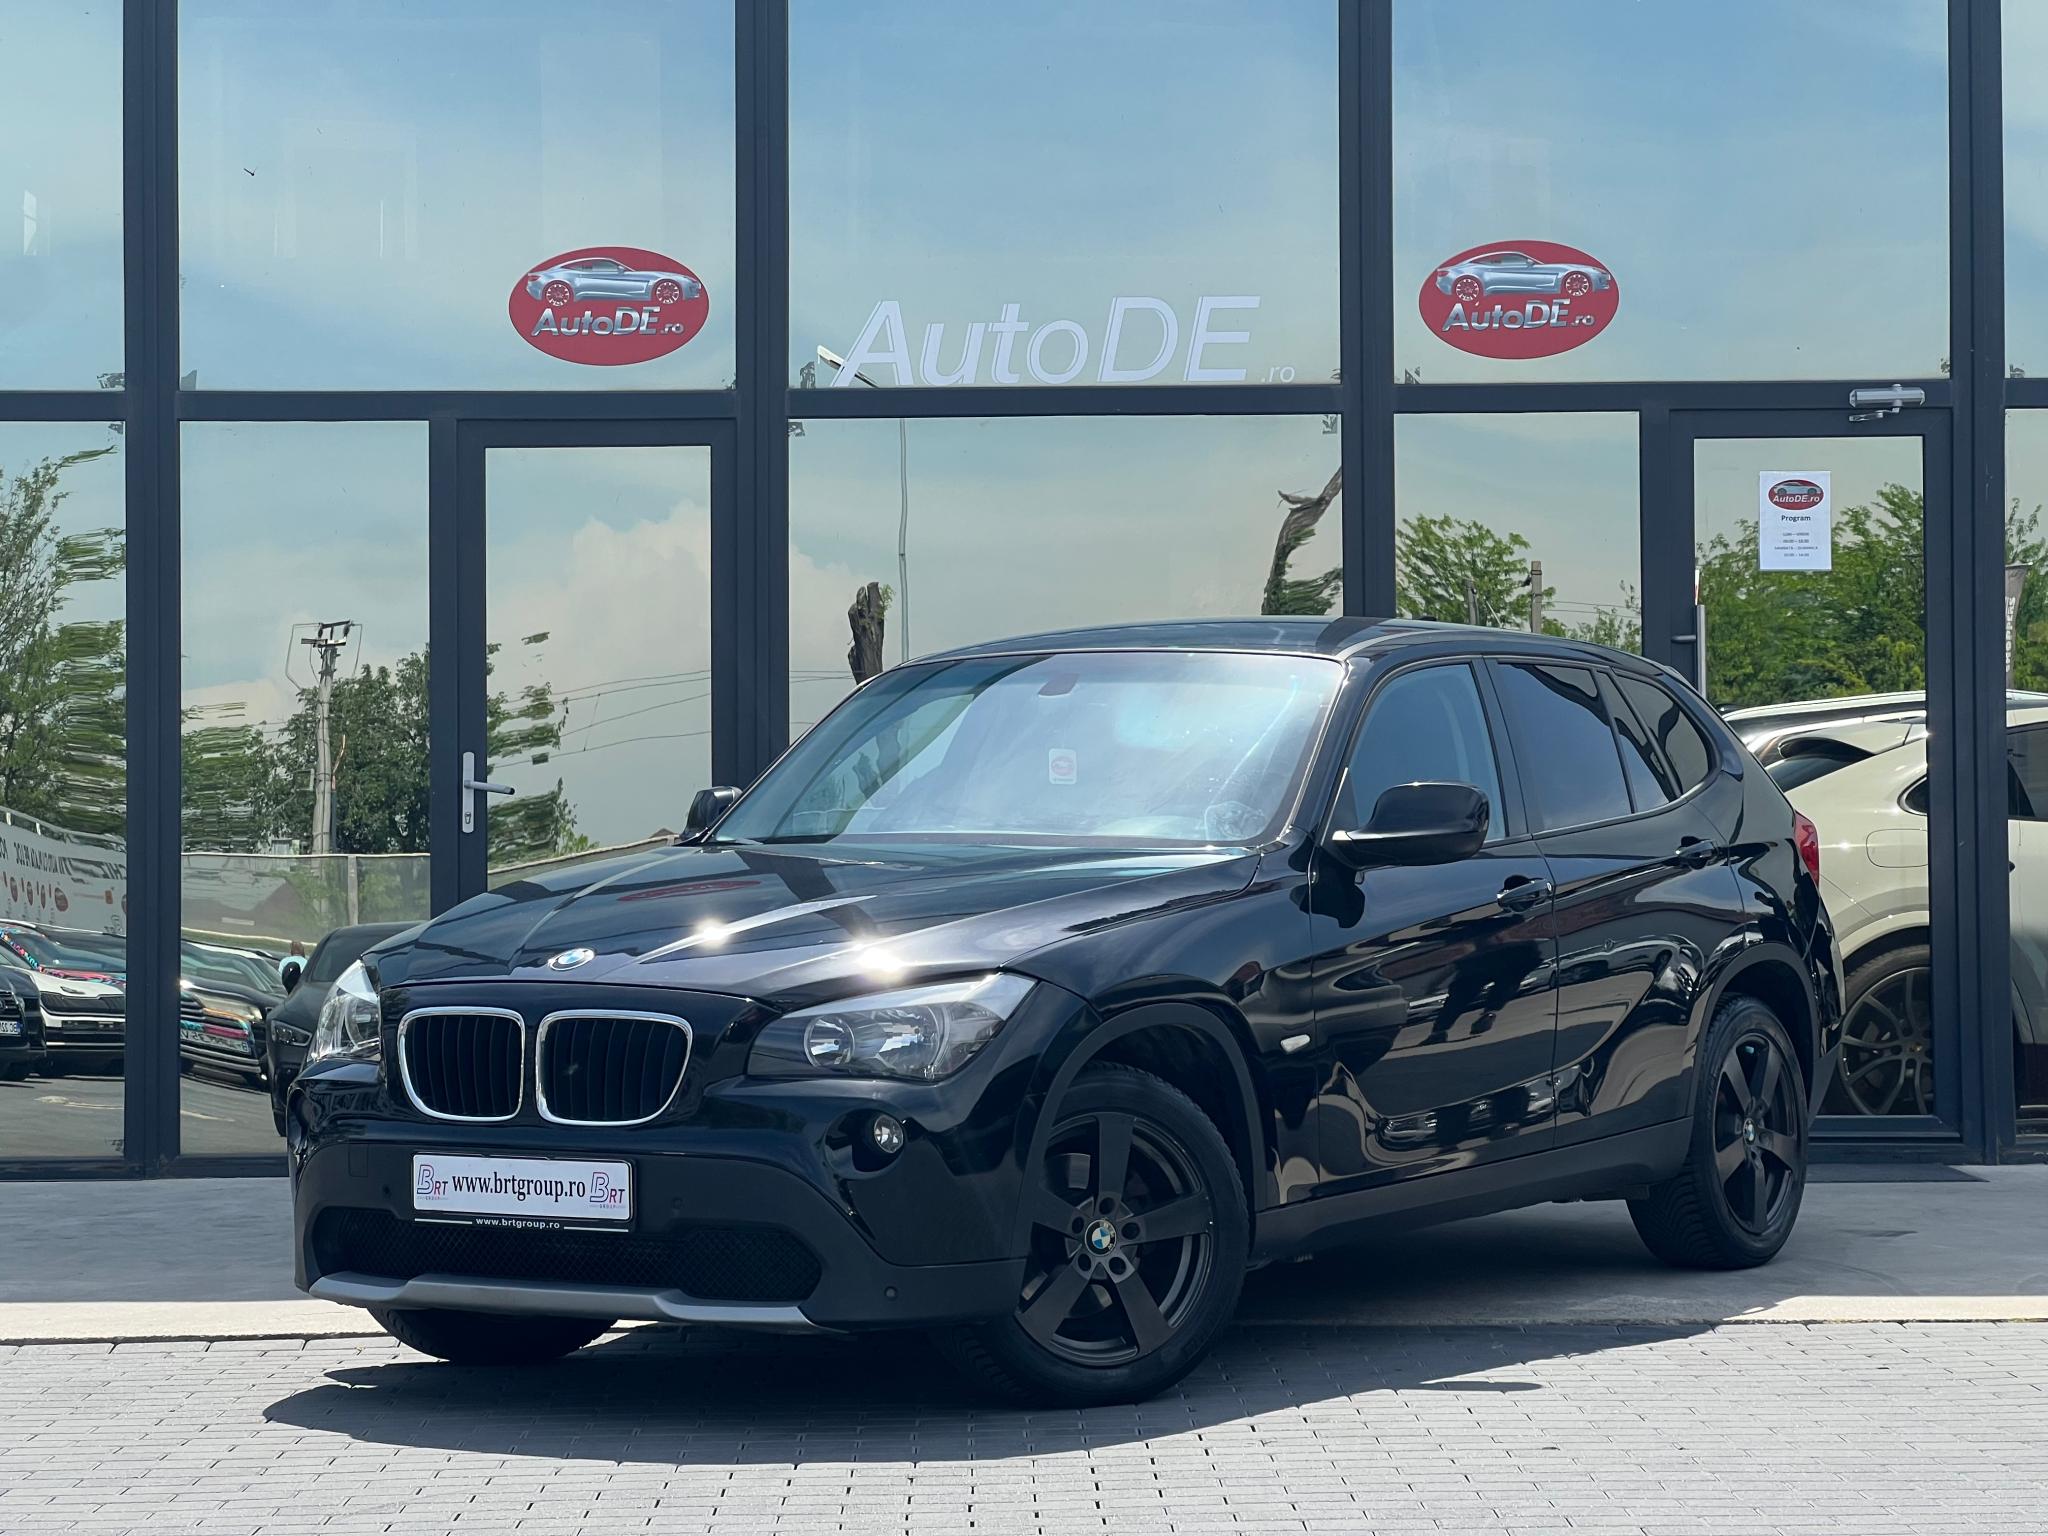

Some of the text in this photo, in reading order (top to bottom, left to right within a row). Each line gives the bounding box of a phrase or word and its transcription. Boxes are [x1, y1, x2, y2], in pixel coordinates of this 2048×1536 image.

[1781, 514, 1811, 522] Program
[417, 1164, 625, 1204] BRT www.brtgroup.ro BRT
[475, 1217, 560, 1230] www.brtgroup.ro
